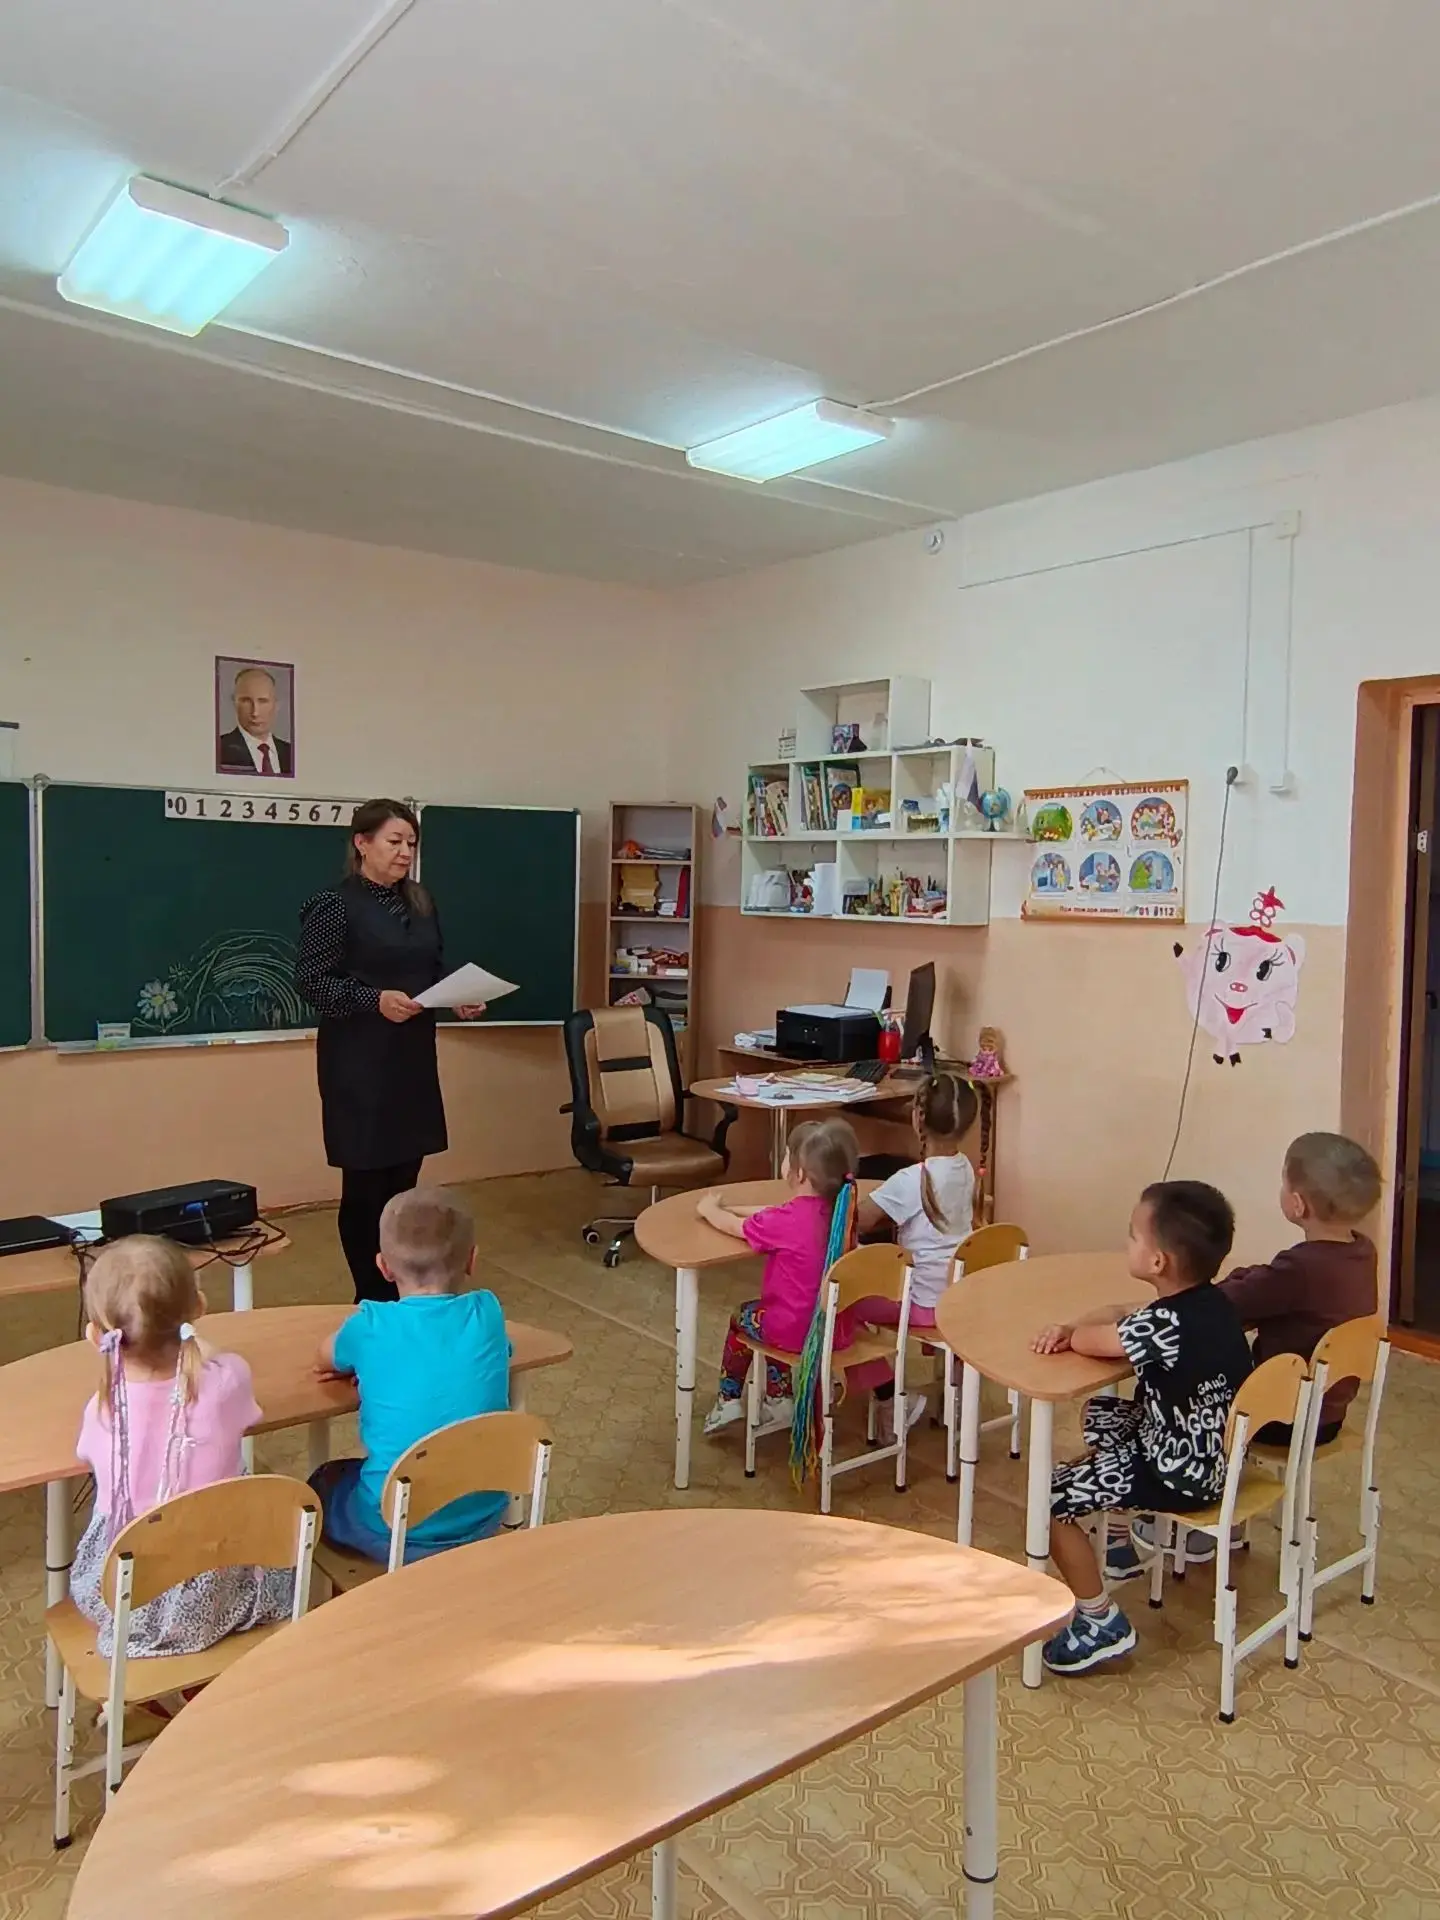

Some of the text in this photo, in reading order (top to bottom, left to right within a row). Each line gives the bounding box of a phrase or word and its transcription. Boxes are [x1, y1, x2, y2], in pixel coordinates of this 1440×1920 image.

[174, 796, 187, 815] 0
[196, 798, 207, 816] 1
[219, 800, 232, 817] 2
[242, 801, 254, 818] 3
[265, 802, 277, 819] 4
[288, 803, 300, 821] 5
[309, 804, 320, 821] 6
[330, 805, 342, 822] 7
